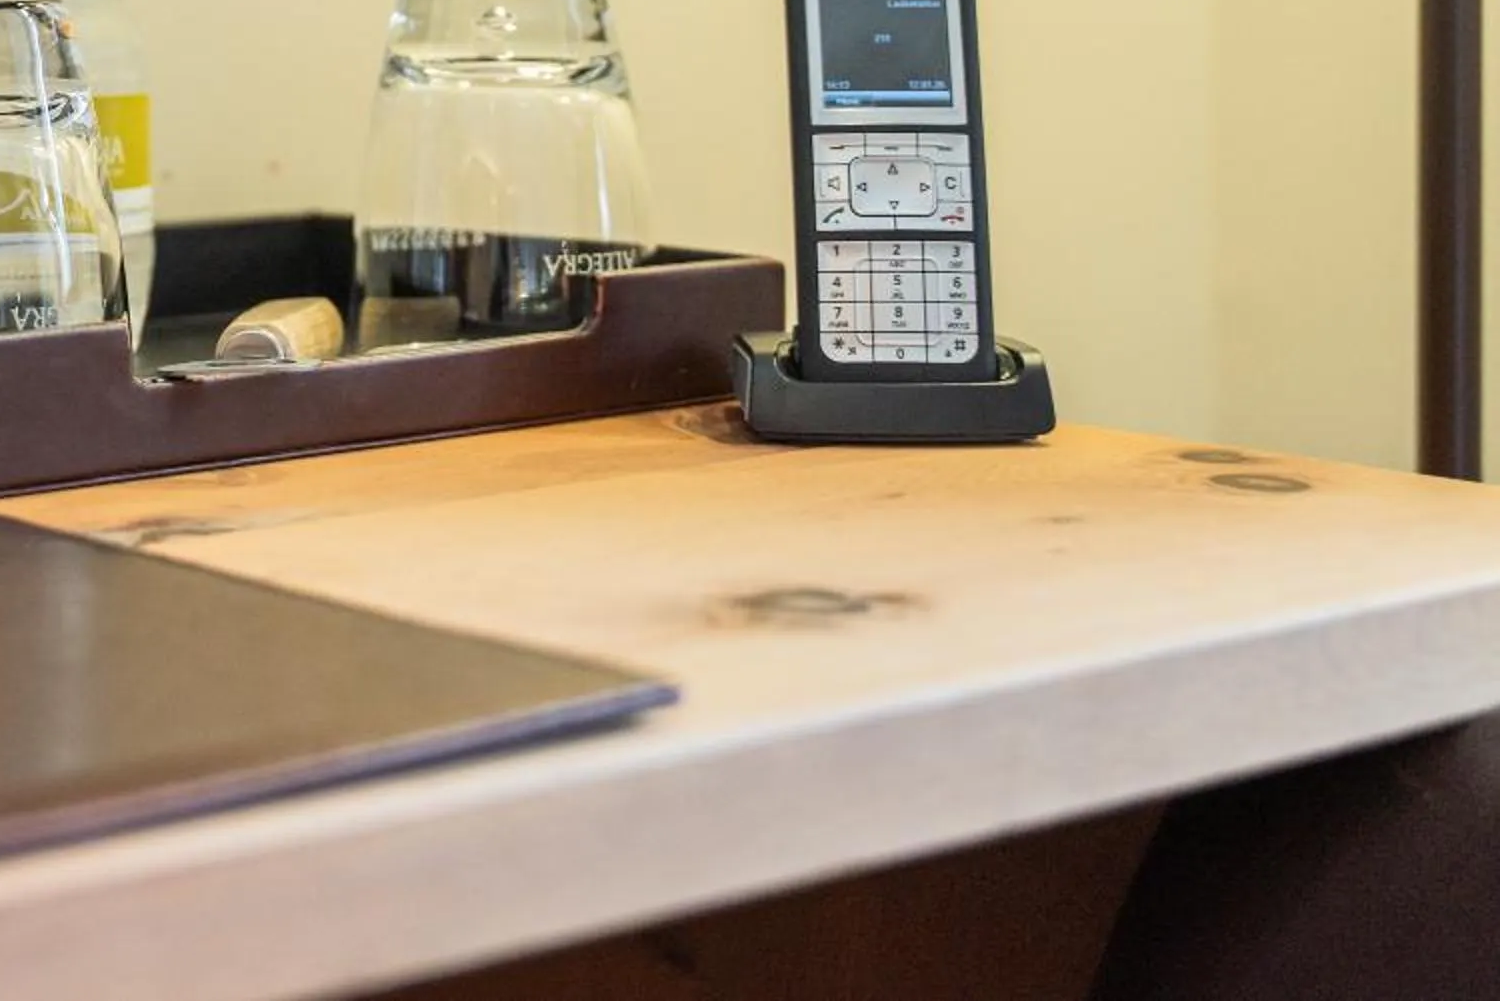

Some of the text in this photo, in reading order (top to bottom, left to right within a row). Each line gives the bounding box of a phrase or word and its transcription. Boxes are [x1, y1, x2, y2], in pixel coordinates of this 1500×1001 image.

[945, 176, 957, 190] C
[891, 244, 901, 255] 2
[952, 246, 961, 257] 3
[832, 277, 841, 287] 4
[893, 275, 902, 286] 5
[953, 277, 962, 288] 6
[833, 306, 842, 319] 7
[894, 306, 903, 318] 8
[953, 307, 963, 319] 9
[895, 348, 905, 359] 0
